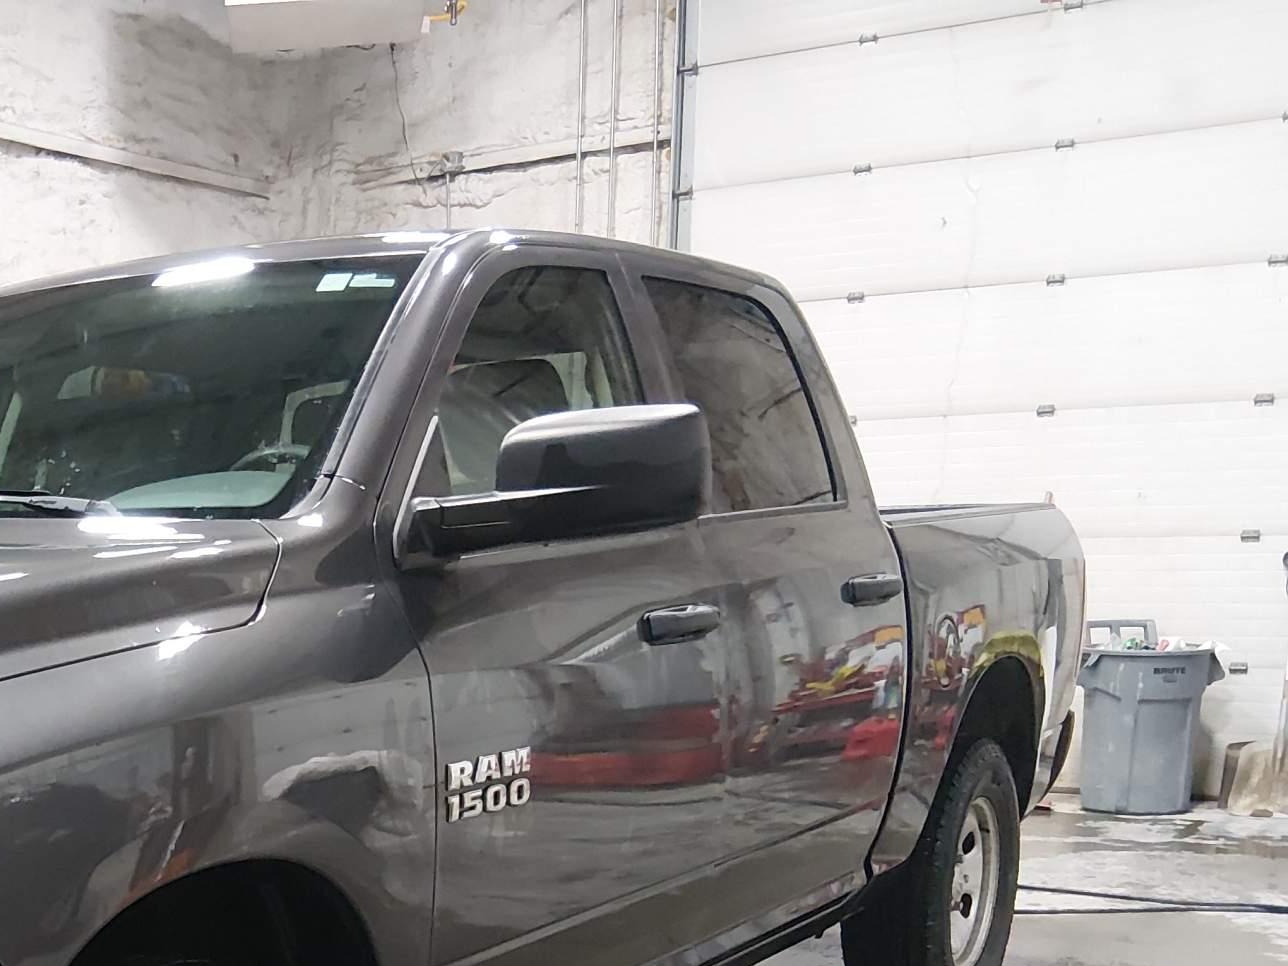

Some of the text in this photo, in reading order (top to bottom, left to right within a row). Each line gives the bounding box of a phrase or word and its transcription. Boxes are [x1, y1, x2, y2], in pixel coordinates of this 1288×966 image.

[1153, 666, 1186, 675] BRUTE
[447, 746, 531, 791] RAM
[447, 778, 531, 823] 1500
